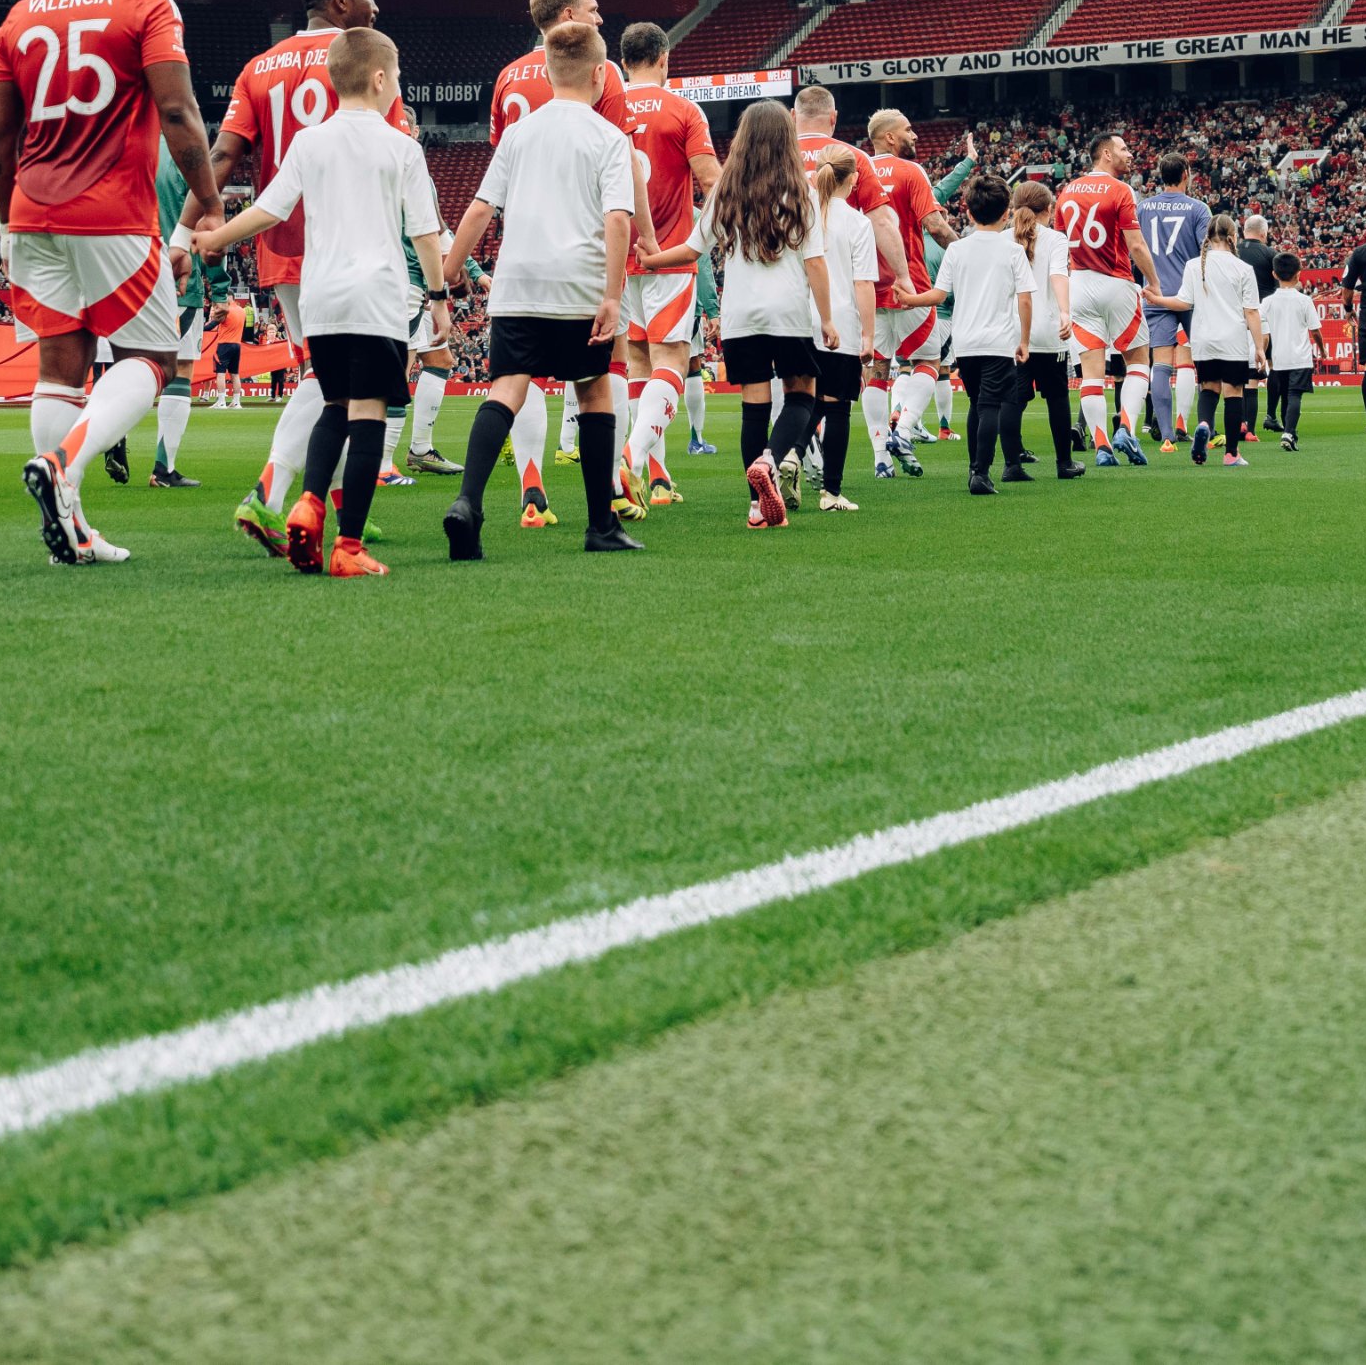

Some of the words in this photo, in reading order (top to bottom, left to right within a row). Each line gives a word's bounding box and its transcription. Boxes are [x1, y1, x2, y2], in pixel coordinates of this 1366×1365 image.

[882, 57, 939, 77] GLORY
[958, 52, 1002, 72] AND
[1011, 44, 1110, 67] HONOUR"
[1124, 40, 1165, 59] THE
[1175, 34, 1245, 56] GREAT
[1259, 29, 1312, 50] MAN
[1321, 25, 1354, 46] HE
[17, 18, 118, 122] 25
[254, 50, 302, 75] DJEMBA
[682, 75, 713, 88] WELCOME
[724, 72, 756, 85] WELCOME
[407, 84, 430, 102] SIR
[435, 84, 482, 102] BOBBY
[679, 87, 713, 101] THEATRE
[715, 87, 725, 99] OF
[726, 83, 761, 98] DREAMS
[625, 98, 663, 114] NSEN
[1065, 183, 1111, 194] BARDSLEY
[1142, 202, 1156, 211] VAN
[1157, 202, 1171, 212] DER
[1172, 202, 1194, 211] GOUW
[1060, 200, 1107, 249] 26
[1150, 216, 1186, 256] 17
